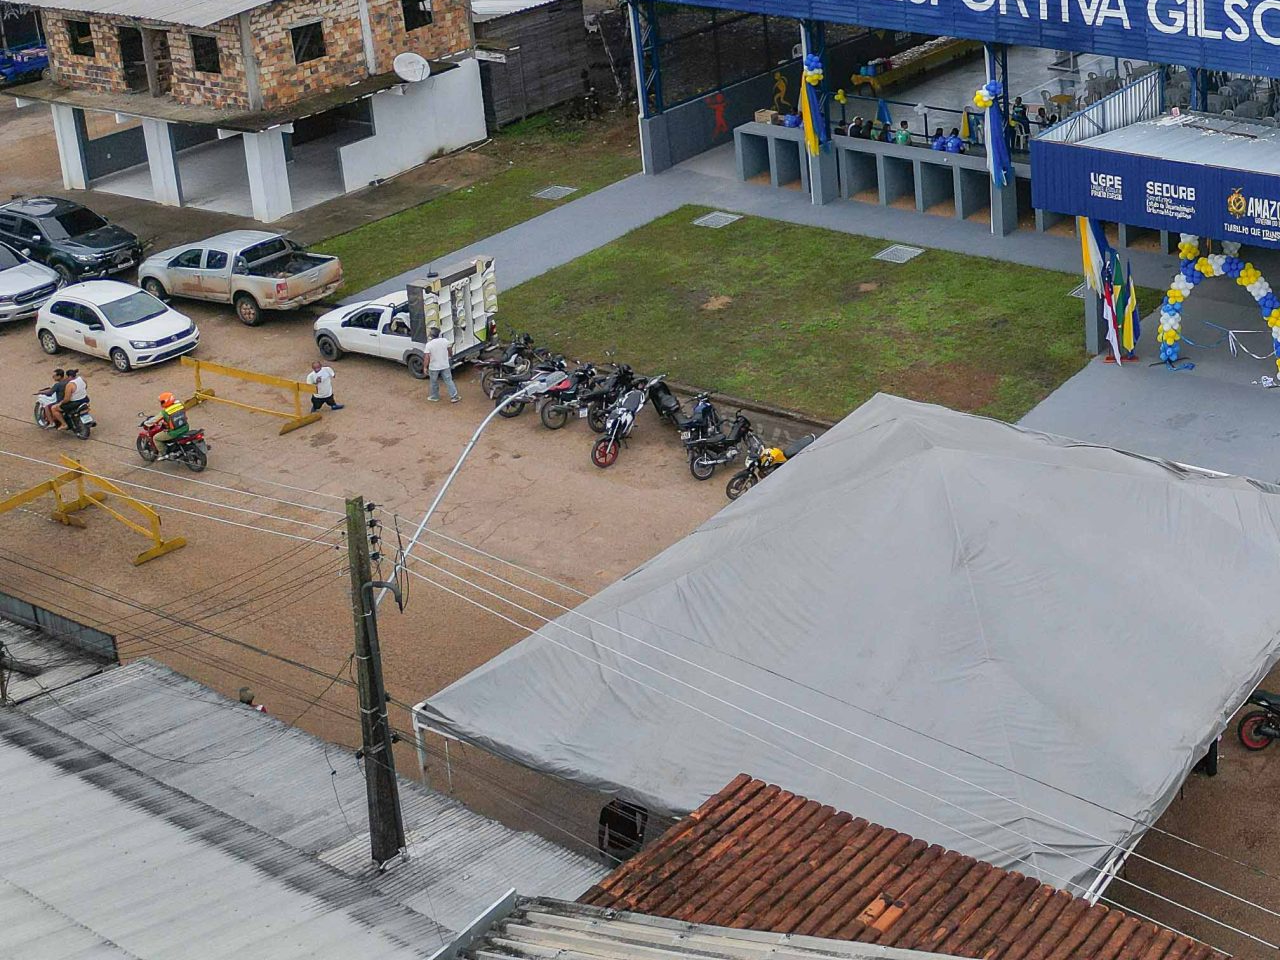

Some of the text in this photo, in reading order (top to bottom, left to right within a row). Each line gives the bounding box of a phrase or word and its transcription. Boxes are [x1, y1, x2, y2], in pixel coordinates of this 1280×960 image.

[1090, 172, 1122, 189] UGPE
[1146, 181, 1196, 201] SEDURB
[1250, 227, 1261, 236] QUE
